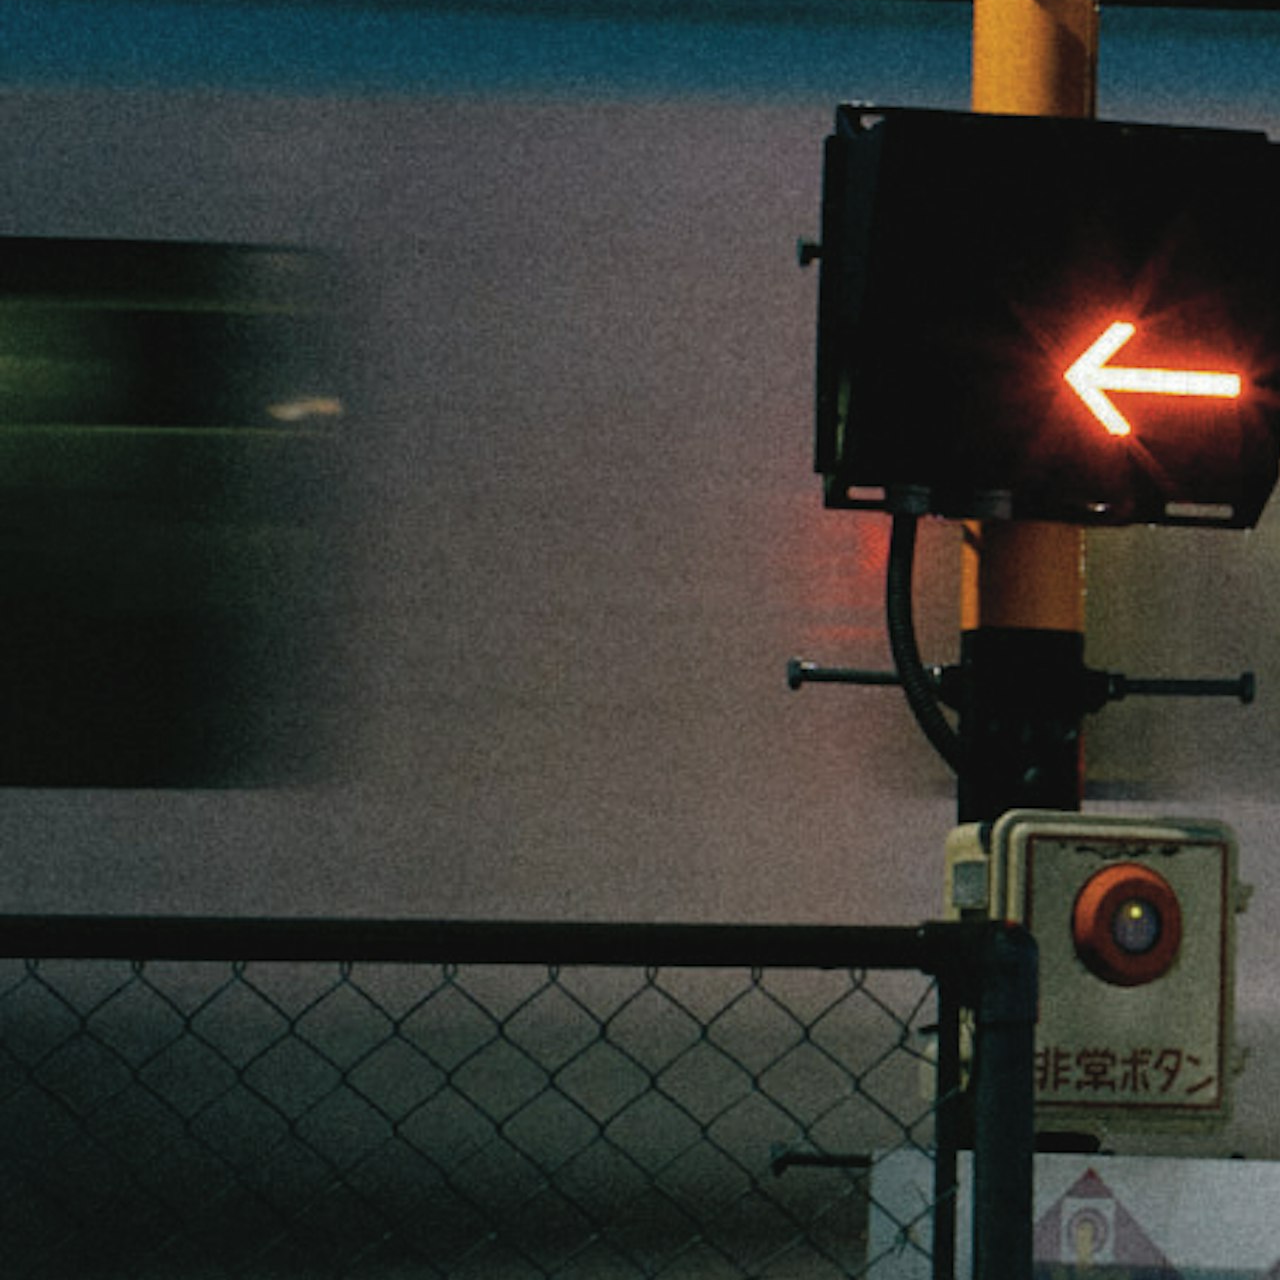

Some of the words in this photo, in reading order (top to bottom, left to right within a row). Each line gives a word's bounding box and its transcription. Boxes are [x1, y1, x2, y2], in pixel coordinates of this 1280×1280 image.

[1034, 1046, 1214, 1094] 非常ボタン
